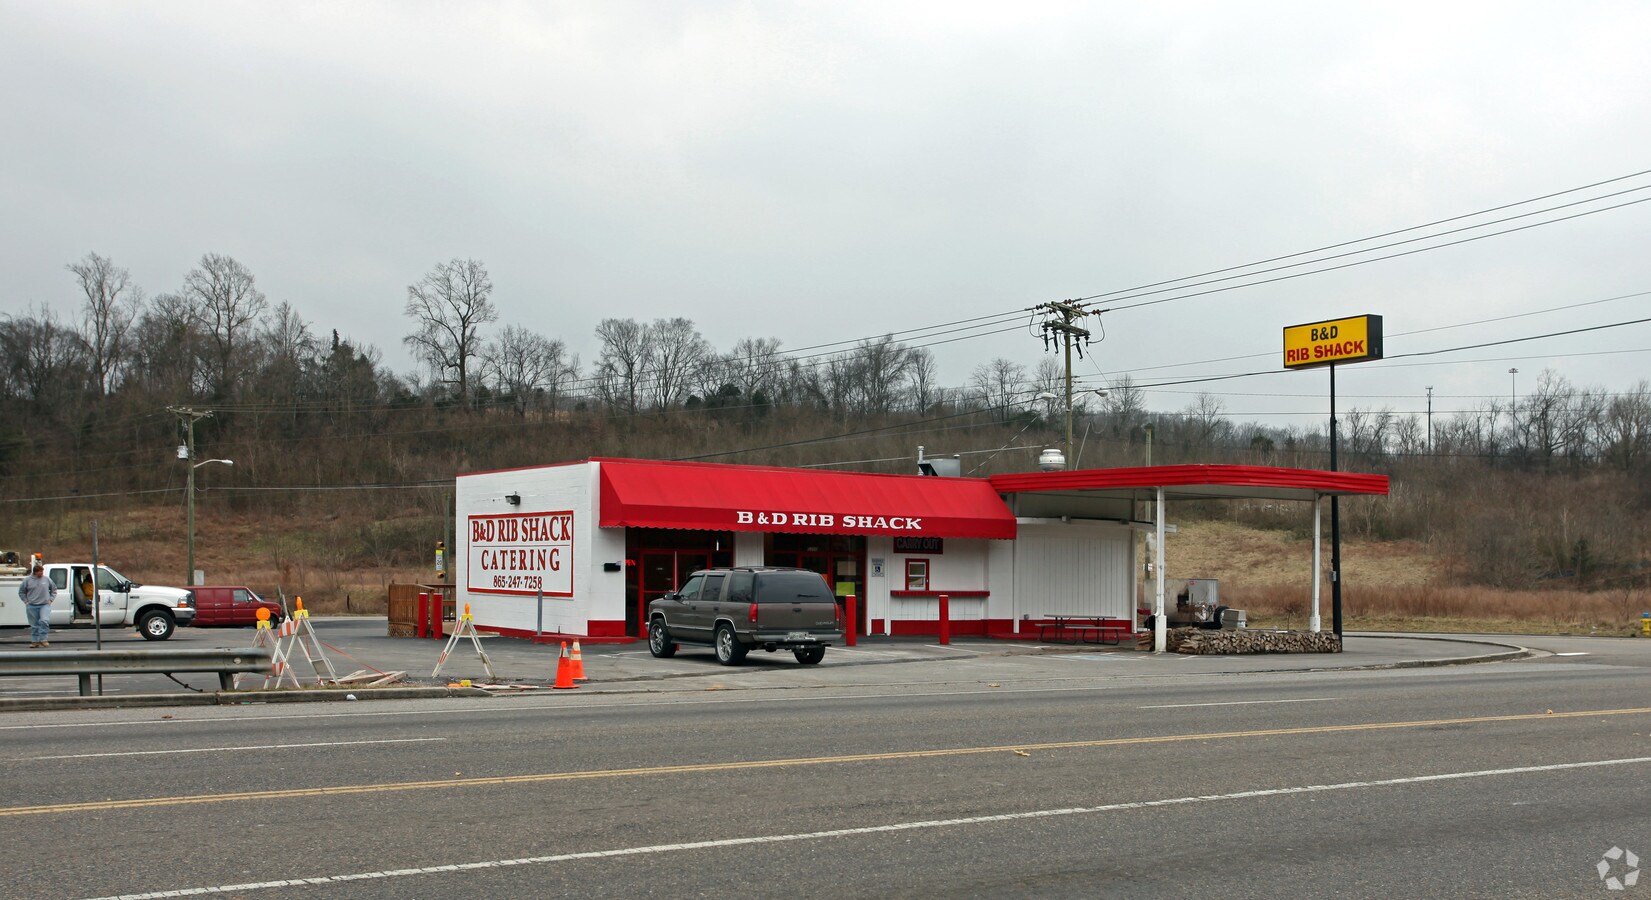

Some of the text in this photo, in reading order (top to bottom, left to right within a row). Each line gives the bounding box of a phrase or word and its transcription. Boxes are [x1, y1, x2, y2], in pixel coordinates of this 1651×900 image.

[1311, 326, 1338, 341] B&D
[1287, 340, 1364, 362] RIB SHACK
[472, 516, 571, 542] B&D RIB SHACK
[792, 513, 834, 527] RIB
[842, 516, 922, 530] SHACK
[923, 538, 938, 550] OUT
[481, 548, 560, 571] CATERING
